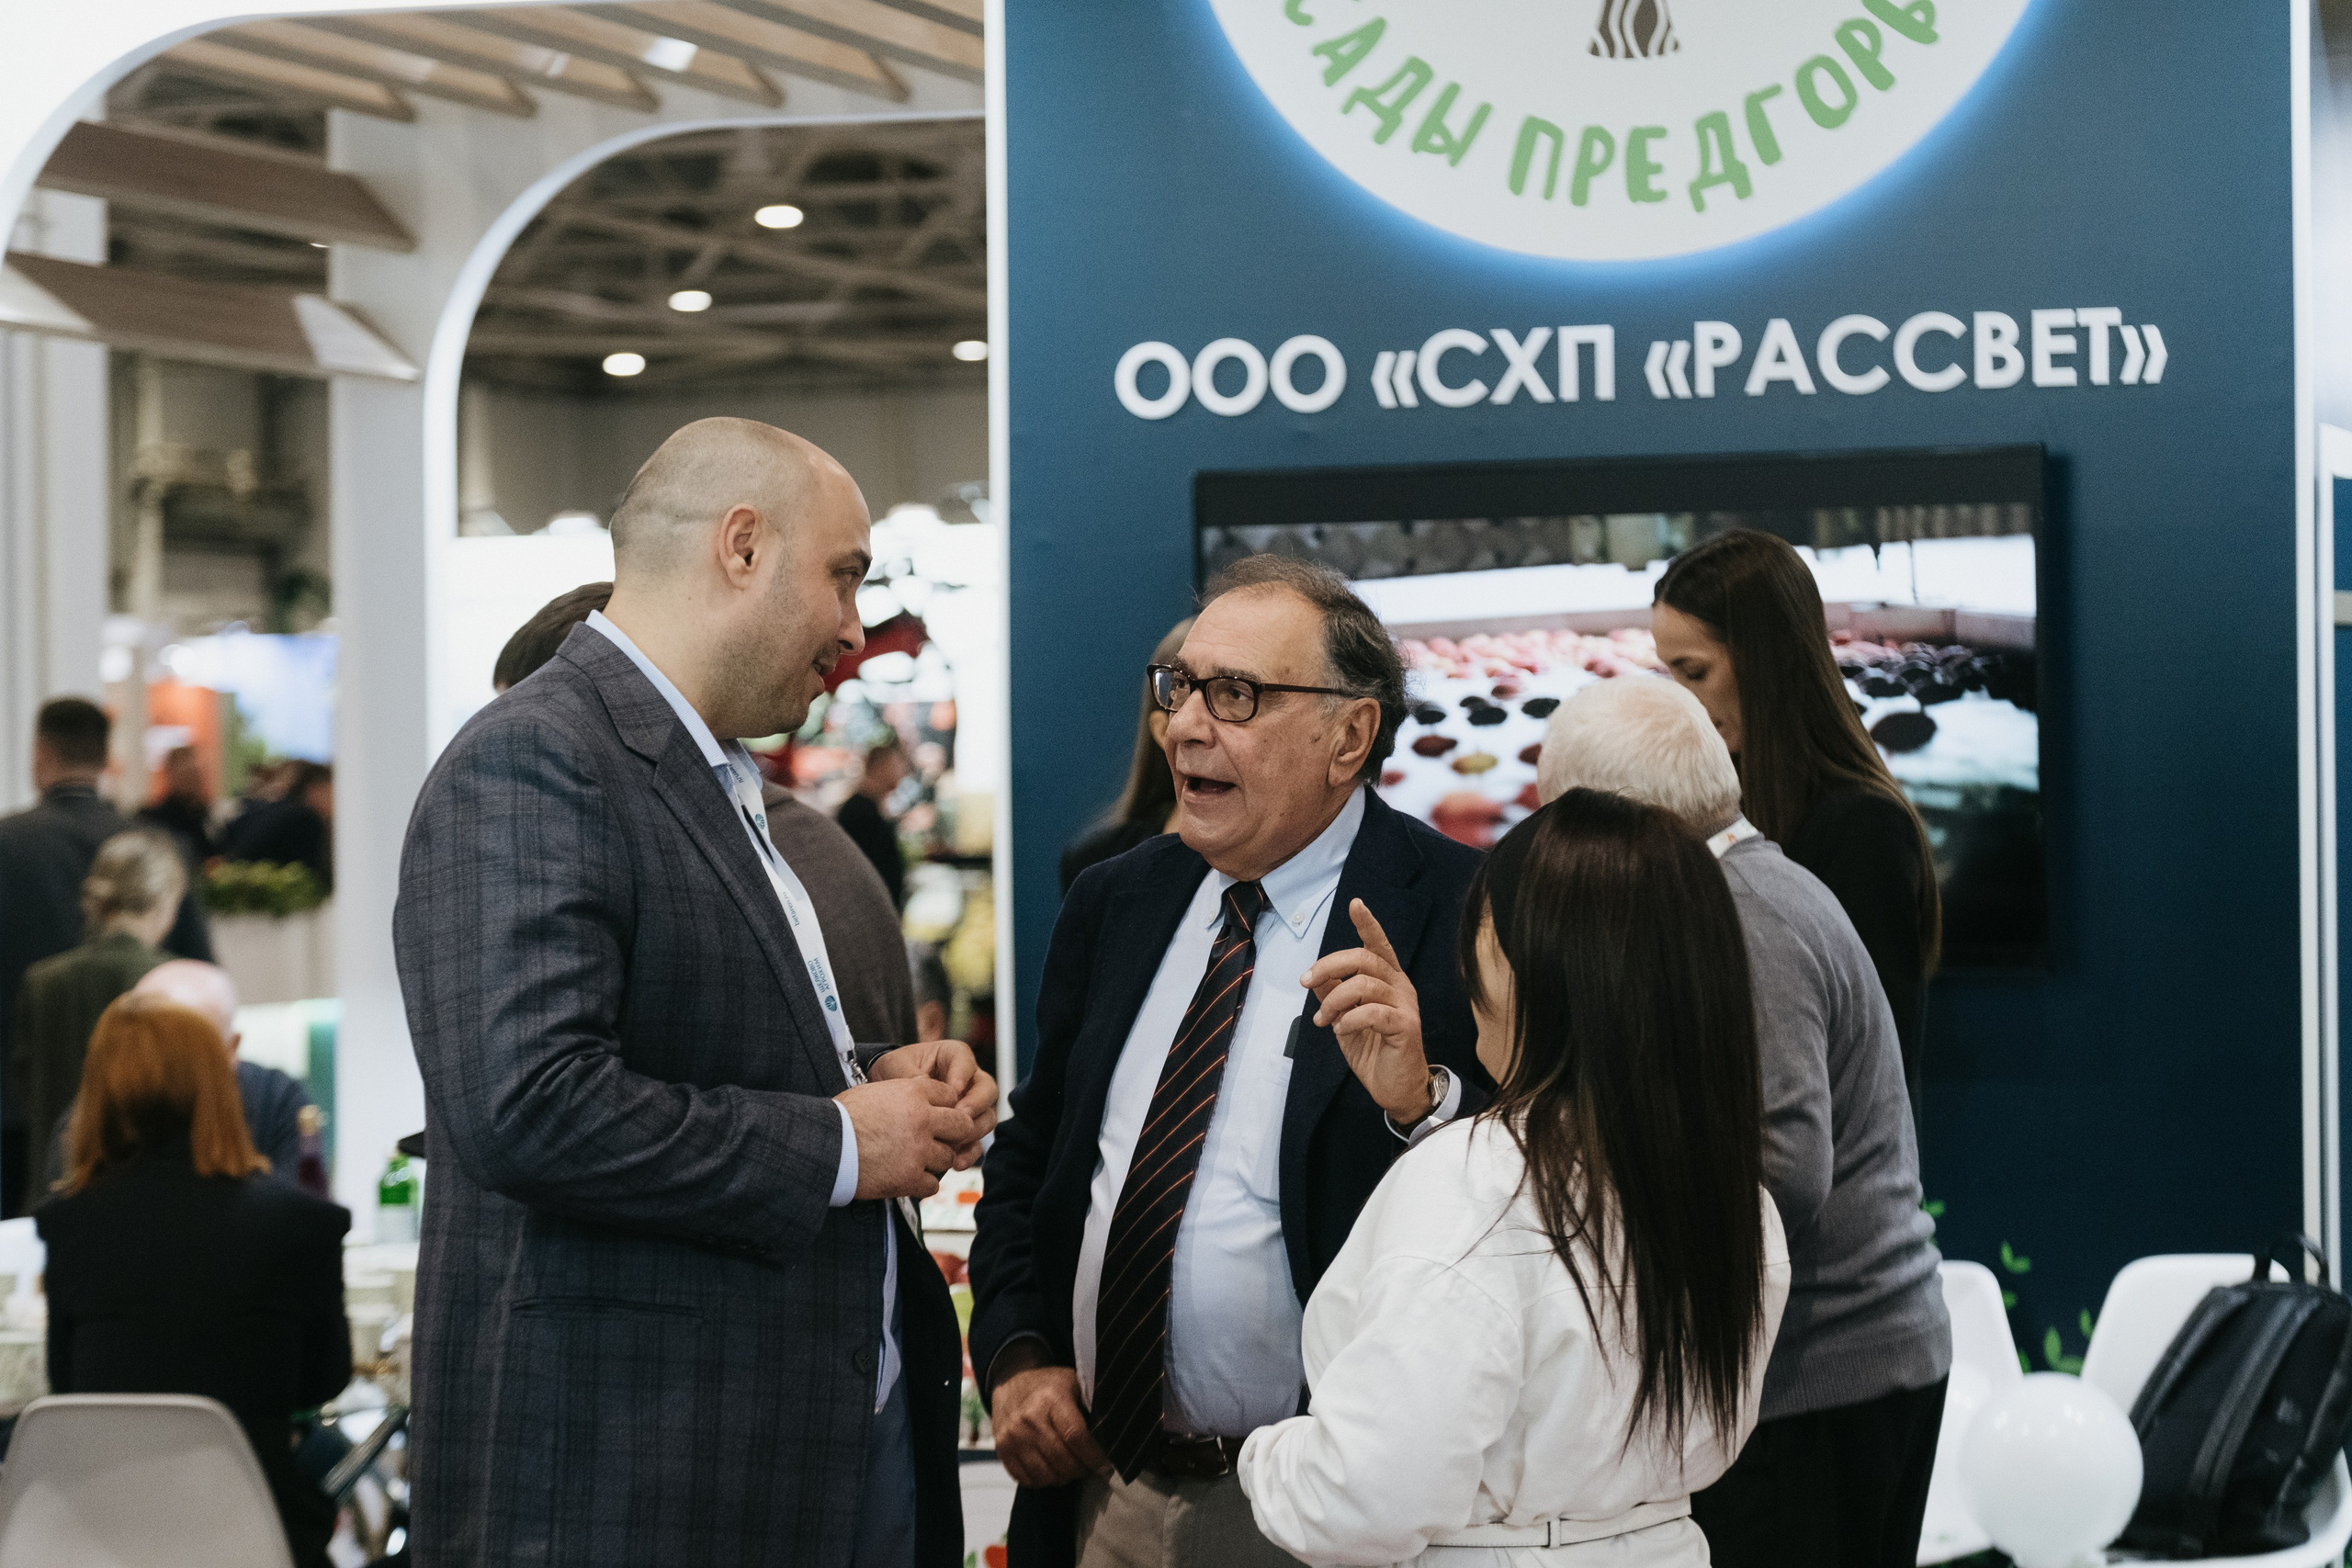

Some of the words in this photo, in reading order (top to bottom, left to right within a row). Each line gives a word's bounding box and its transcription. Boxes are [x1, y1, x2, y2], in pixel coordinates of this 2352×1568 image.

[1113, 333, 1348, 421] ООО
[1371, 324, 1615, 409] «СХП
[1644, 305, 2169, 399] «РАССВЕТ»
[813, 957, 831, 990] АГРОХИМ
